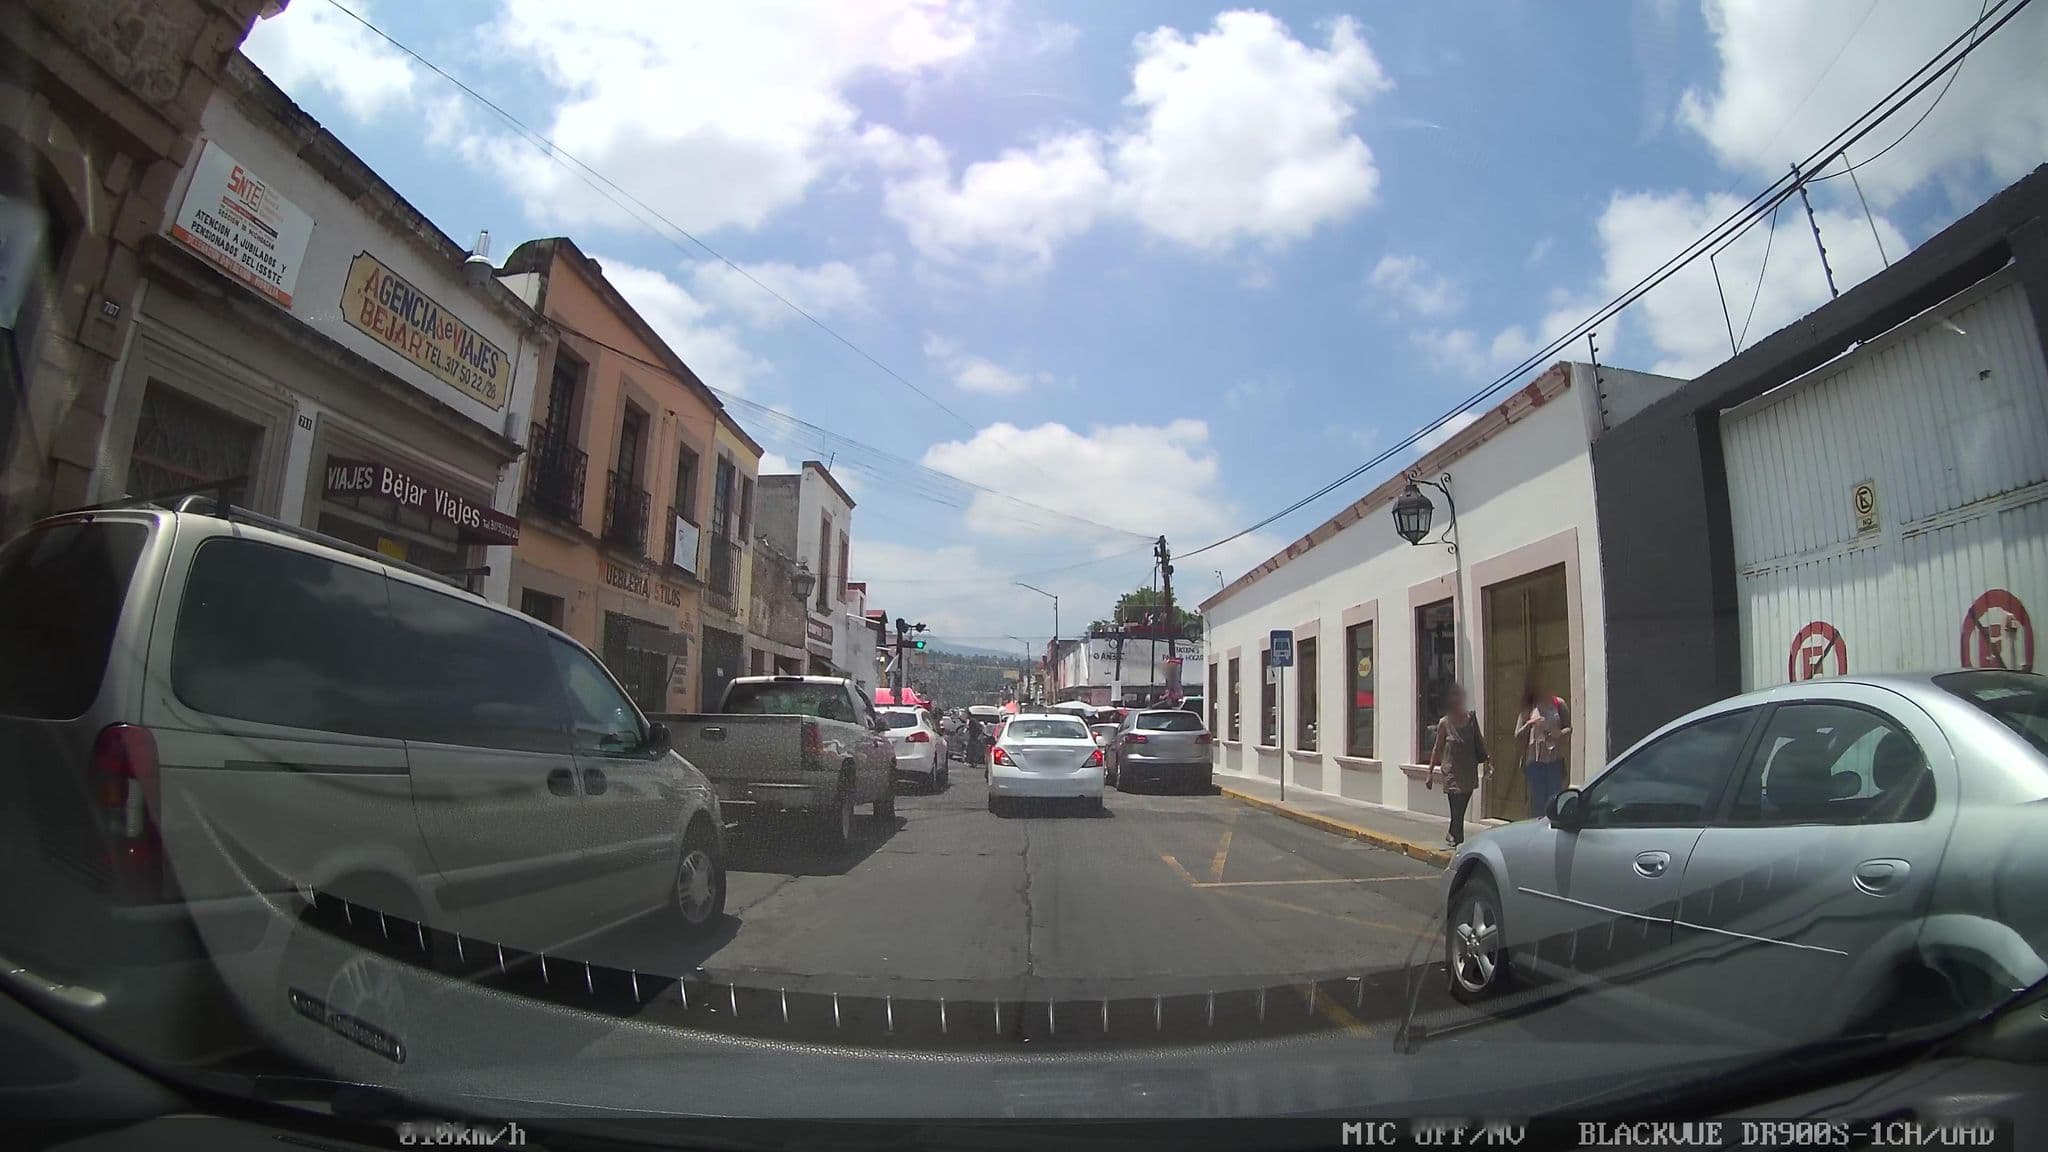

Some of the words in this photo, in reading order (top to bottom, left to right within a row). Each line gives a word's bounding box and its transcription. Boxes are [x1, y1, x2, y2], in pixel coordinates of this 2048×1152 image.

[227, 165, 262, 207] SNTE
[190, 220, 238, 257] PENSIONADOS
[241, 253, 254, 269] DEL
[255, 262, 283, 285] ISSSTE
[195, 209, 231, 237] ATENCION
[233, 233, 239, 244] A
[240, 239, 277, 268] JUBILADOS
[281, 263, 288, 274] Y
[360, 297, 422, 359] BEJAR
[364, 267, 437, 339] AGENCIA
[436, 316, 453, 341] de
[452, 323, 499, 378] VIAJES
[328, 466, 374, 490] VIAJES
[381, 467, 427, 506] Béjar
[434, 487, 480, 528] Viajes
[651, 580, 680, 608] STILOS
